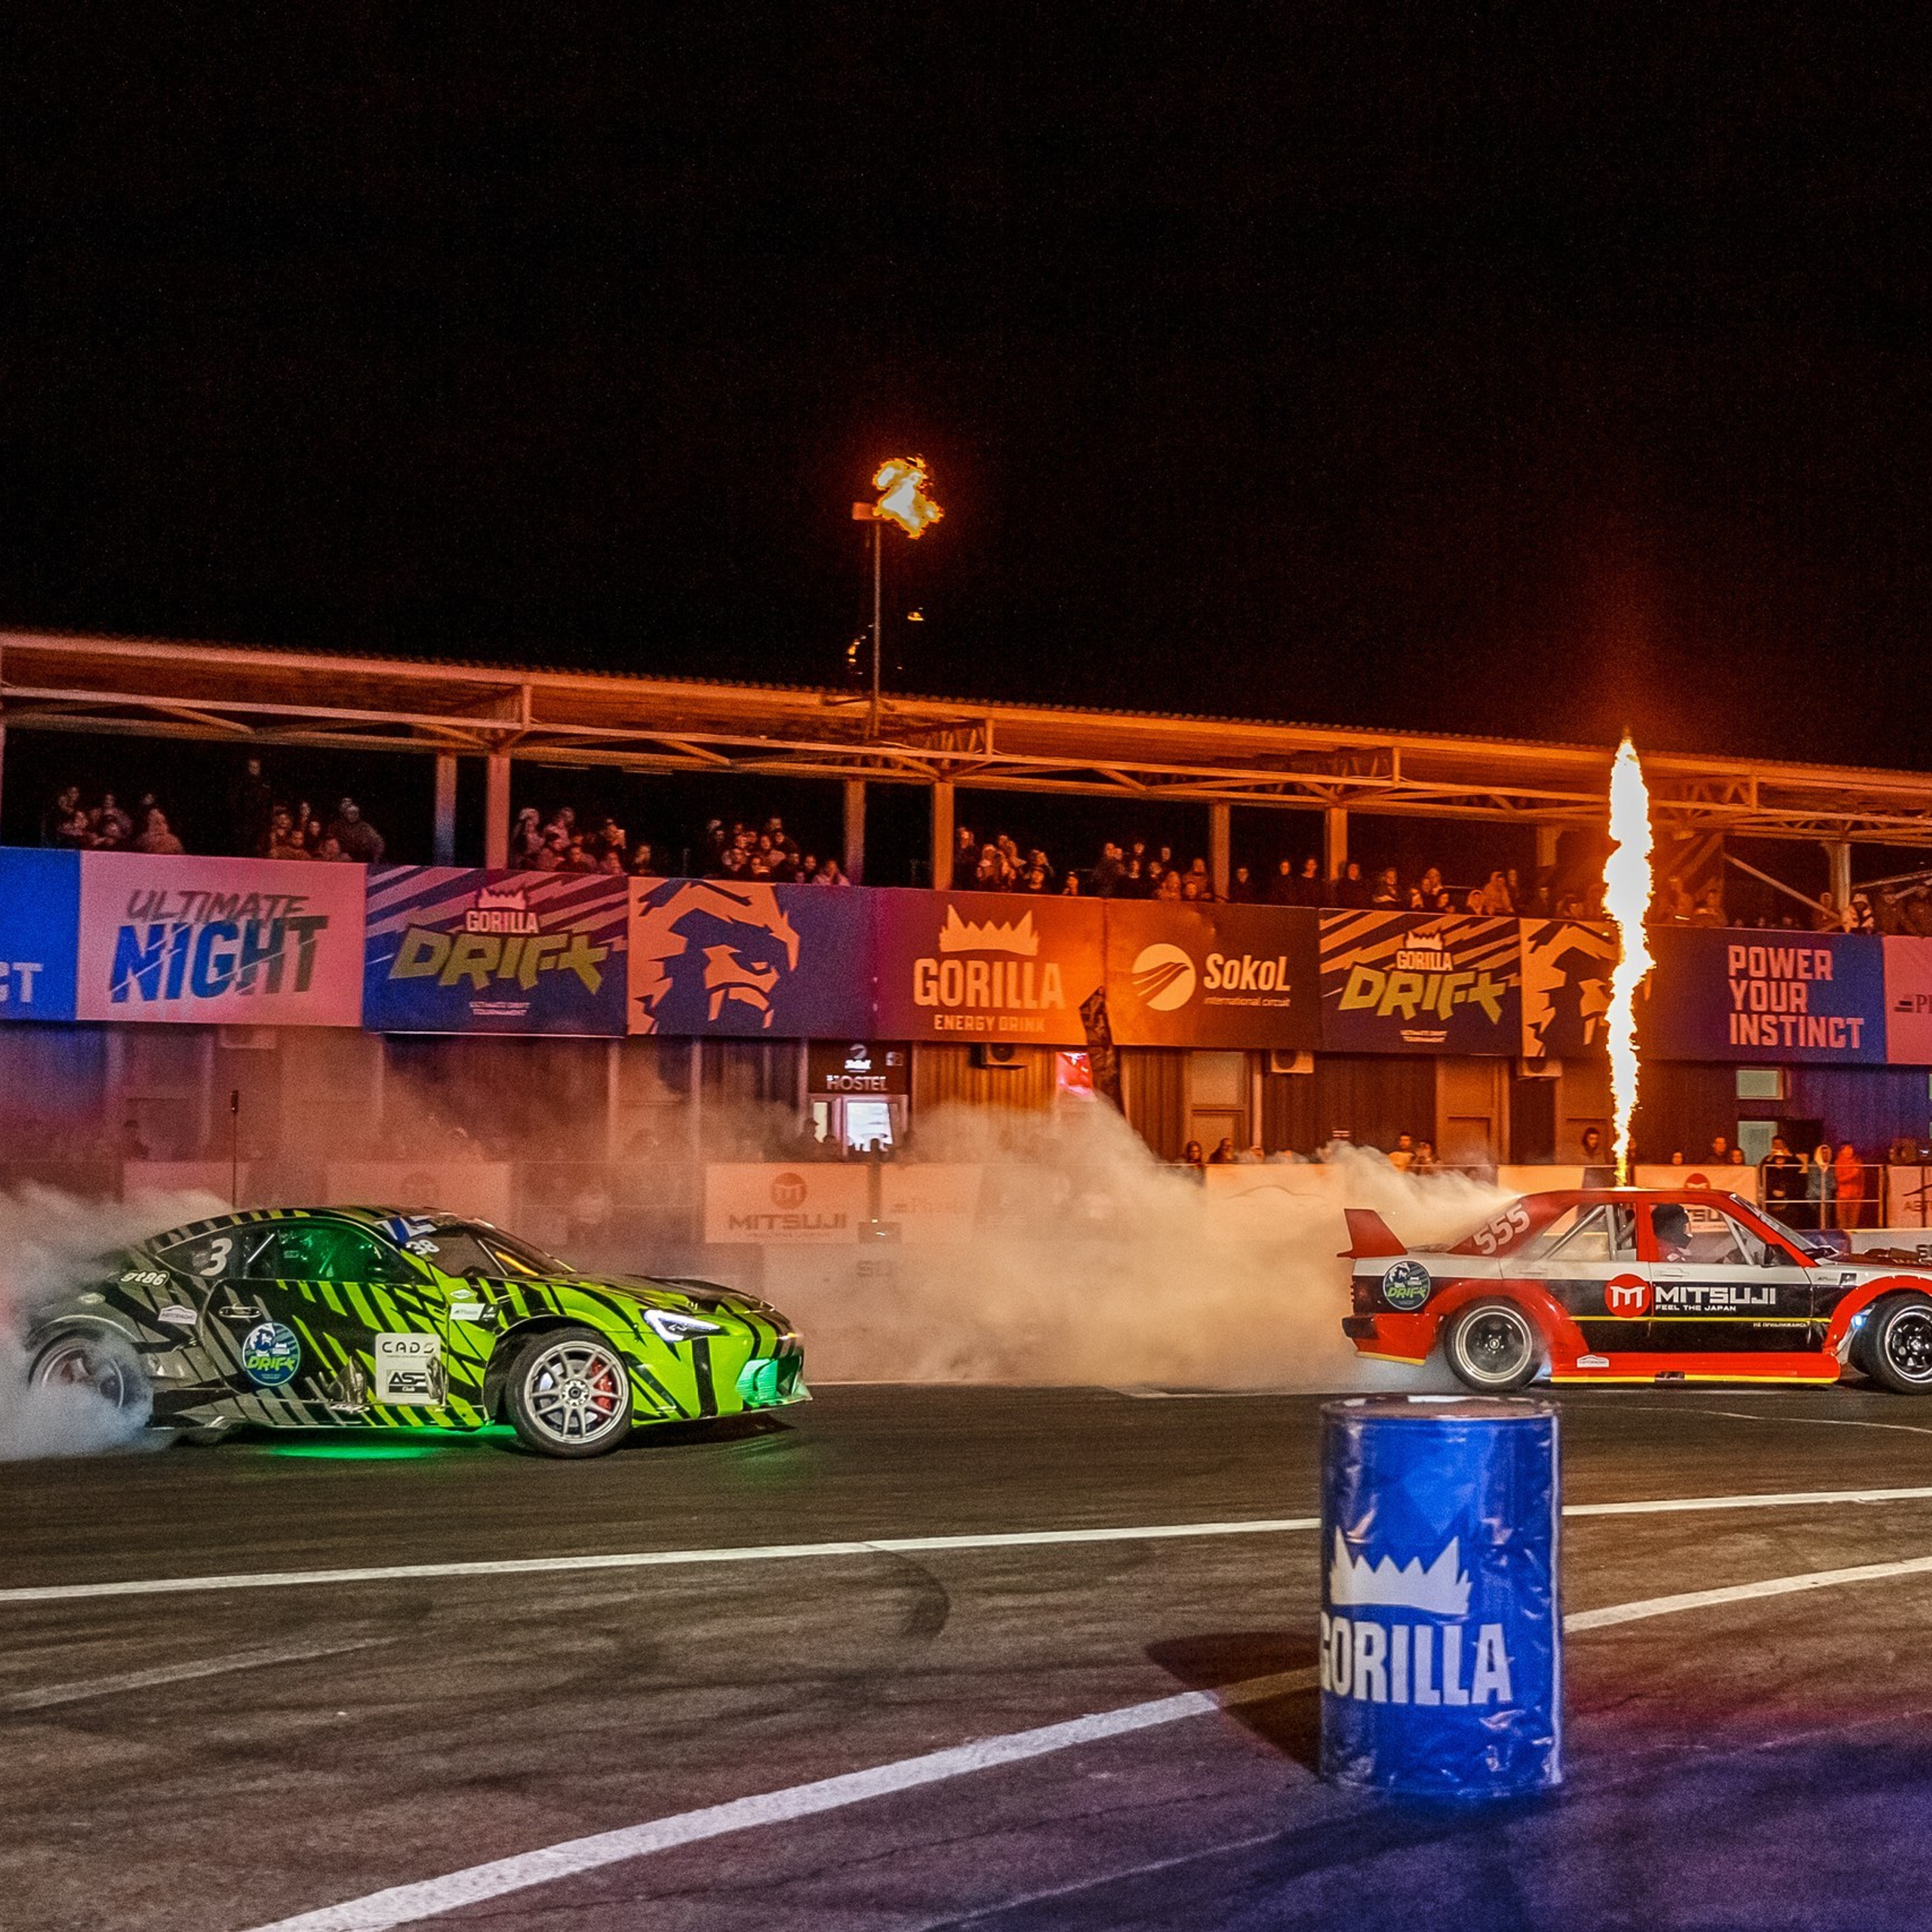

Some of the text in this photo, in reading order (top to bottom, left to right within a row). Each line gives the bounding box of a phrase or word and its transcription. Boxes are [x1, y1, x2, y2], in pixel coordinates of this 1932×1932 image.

[126, 889, 310, 924] ULTIMATE
[466, 911, 540, 934] GORILLA
[109, 915, 330, 1003] NIGHT
[1396, 951, 1454, 971] GORILLA
[1728, 945, 1833, 980] POWER
[914, 958, 1066, 1009] GORILLA
[1728, 980, 1807, 1013] YOUR
[934, 1014, 1045, 1032] ENERGY DRINK
[1730, 1014, 1864, 1048] INSTINCT
[826, 1075, 888, 1091] HOSTEL
[728, 1214, 848, 1230] MITSUJI
[1472, 1203, 1530, 1254] 555
[200, 1238, 232, 1276] 3
[405, 1239, 440, 1255] 38
[121, 1272, 167, 1286] gt86
[1655, 1287, 1776, 1304] MITSUJI
[382, 1342, 434, 1353] CADS
